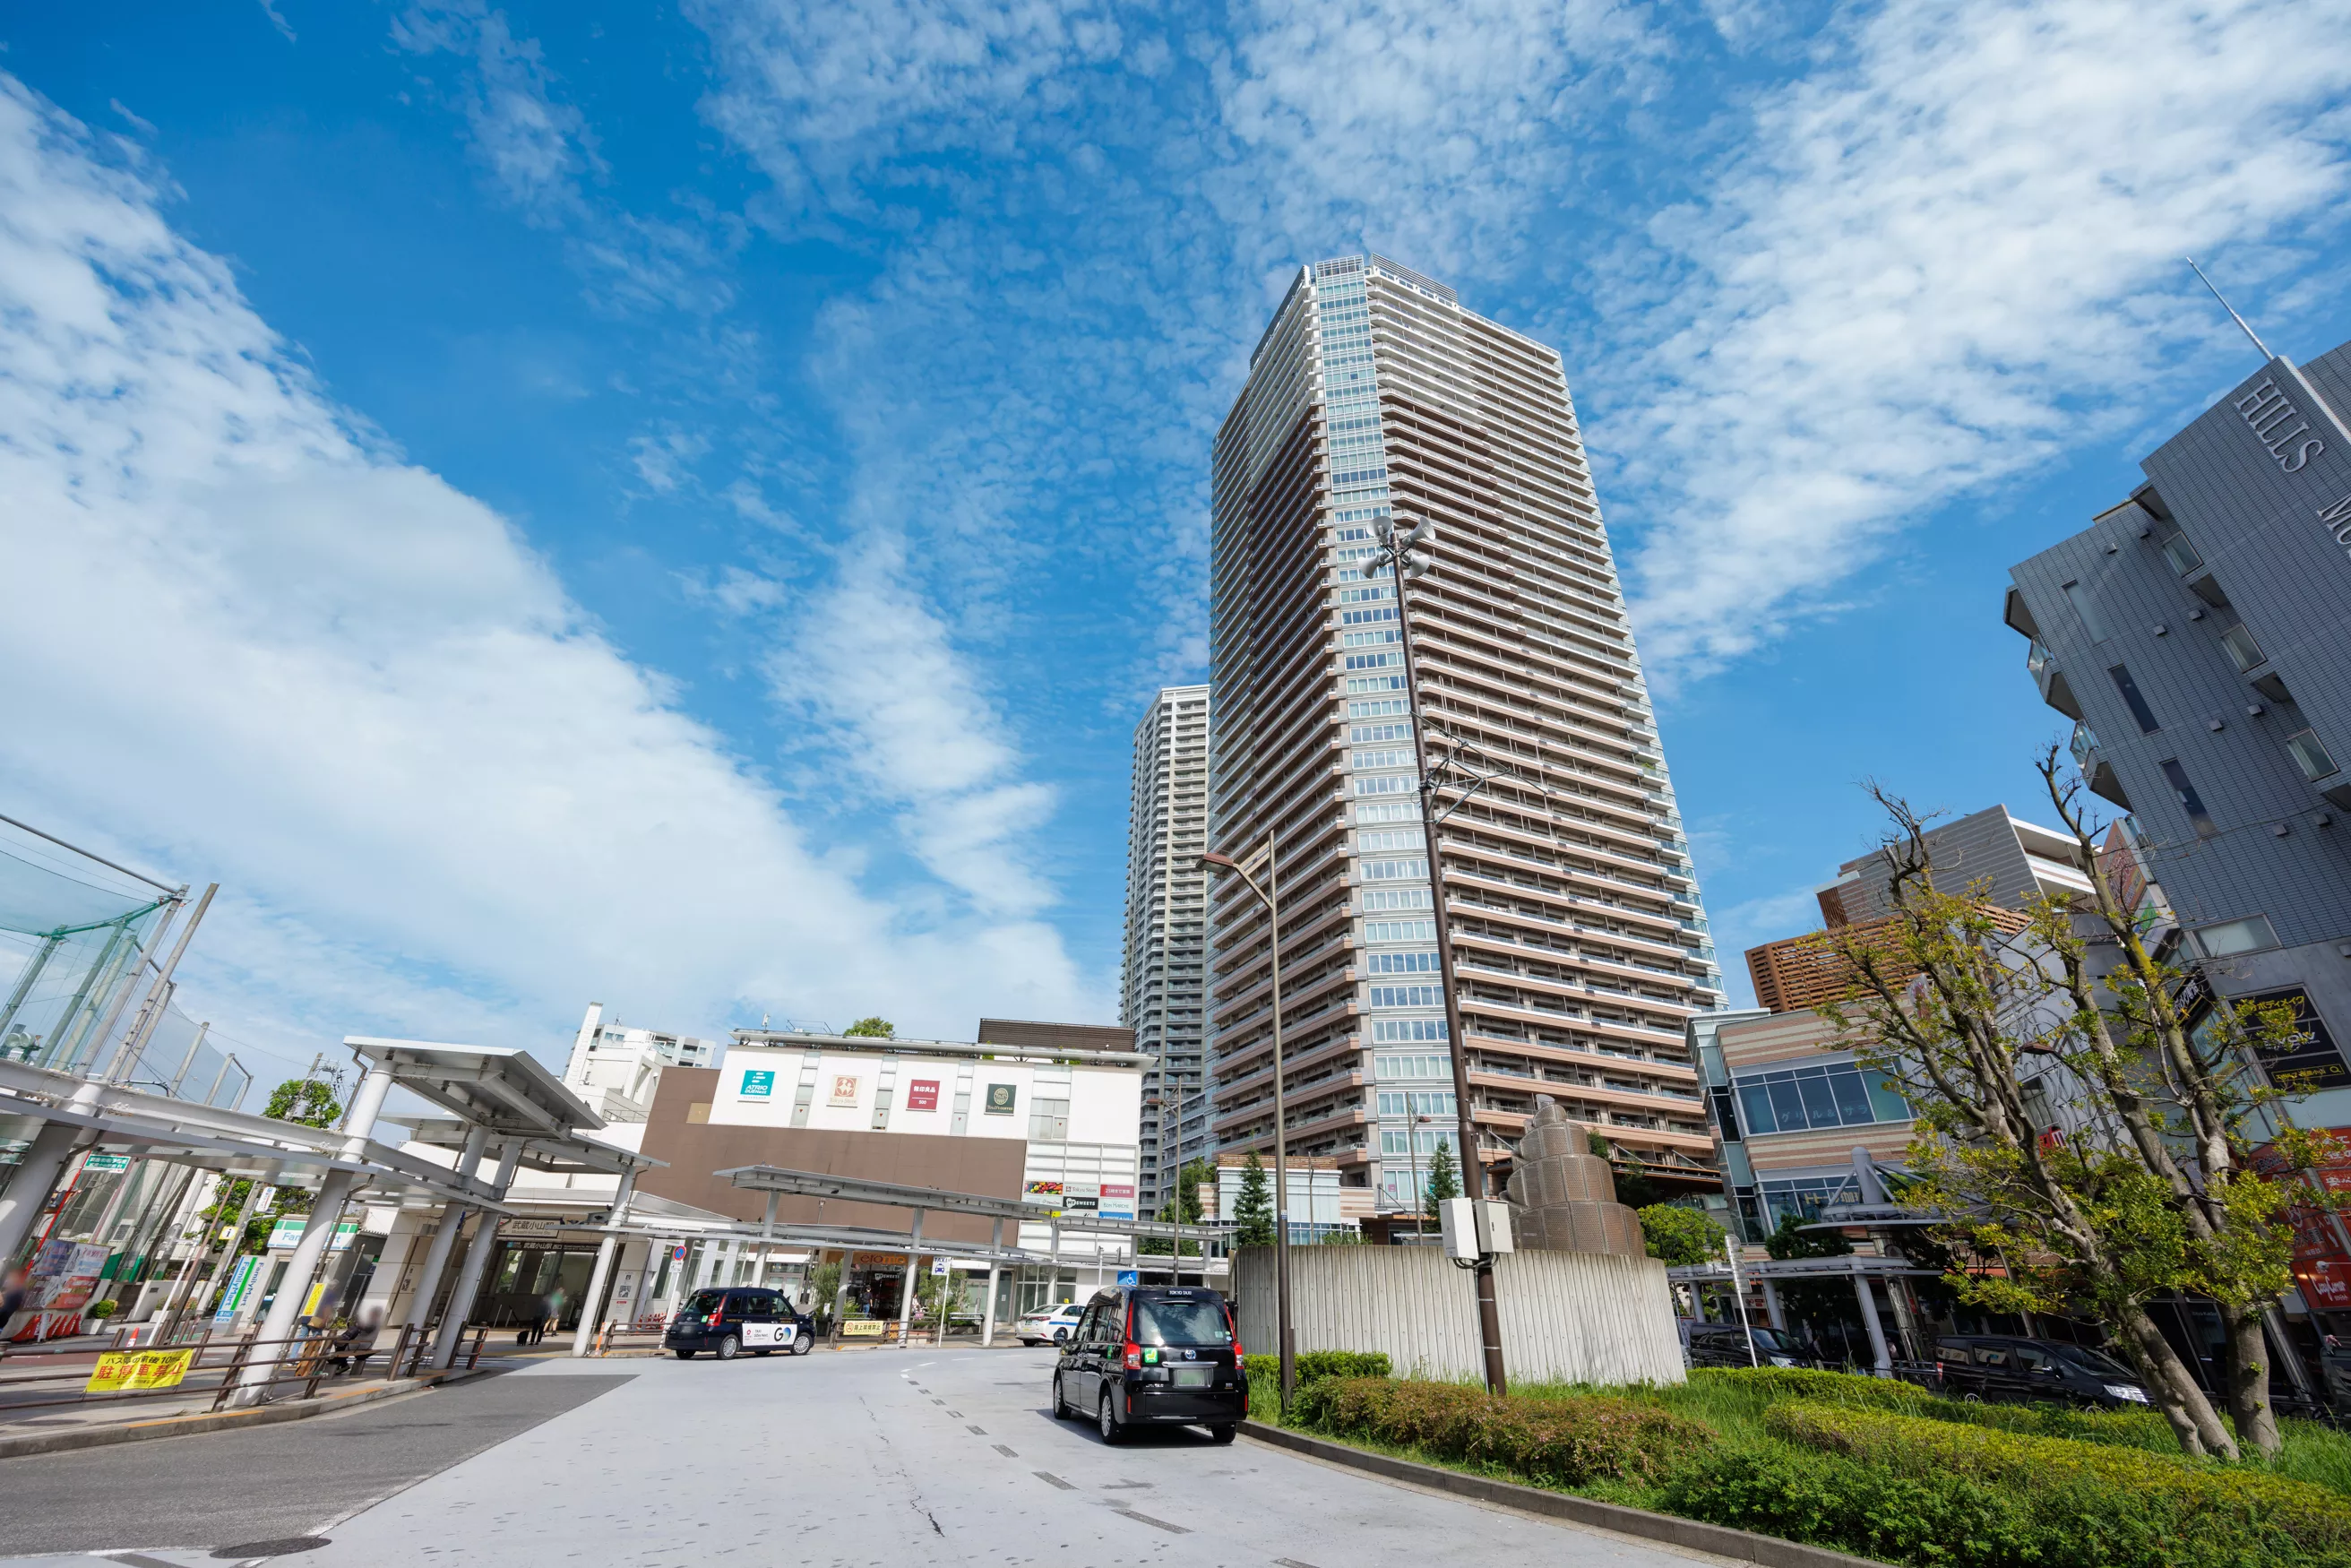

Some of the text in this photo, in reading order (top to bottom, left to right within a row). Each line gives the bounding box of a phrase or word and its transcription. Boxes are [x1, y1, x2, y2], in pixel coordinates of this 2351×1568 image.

[2234, 377, 2325, 473] HILLS
[225, 1262, 250, 1306] FamilyMart
[240, 1262, 265, 1306] FamilyMart
[96, 1361, 184, 1380] 駐停車禁止
